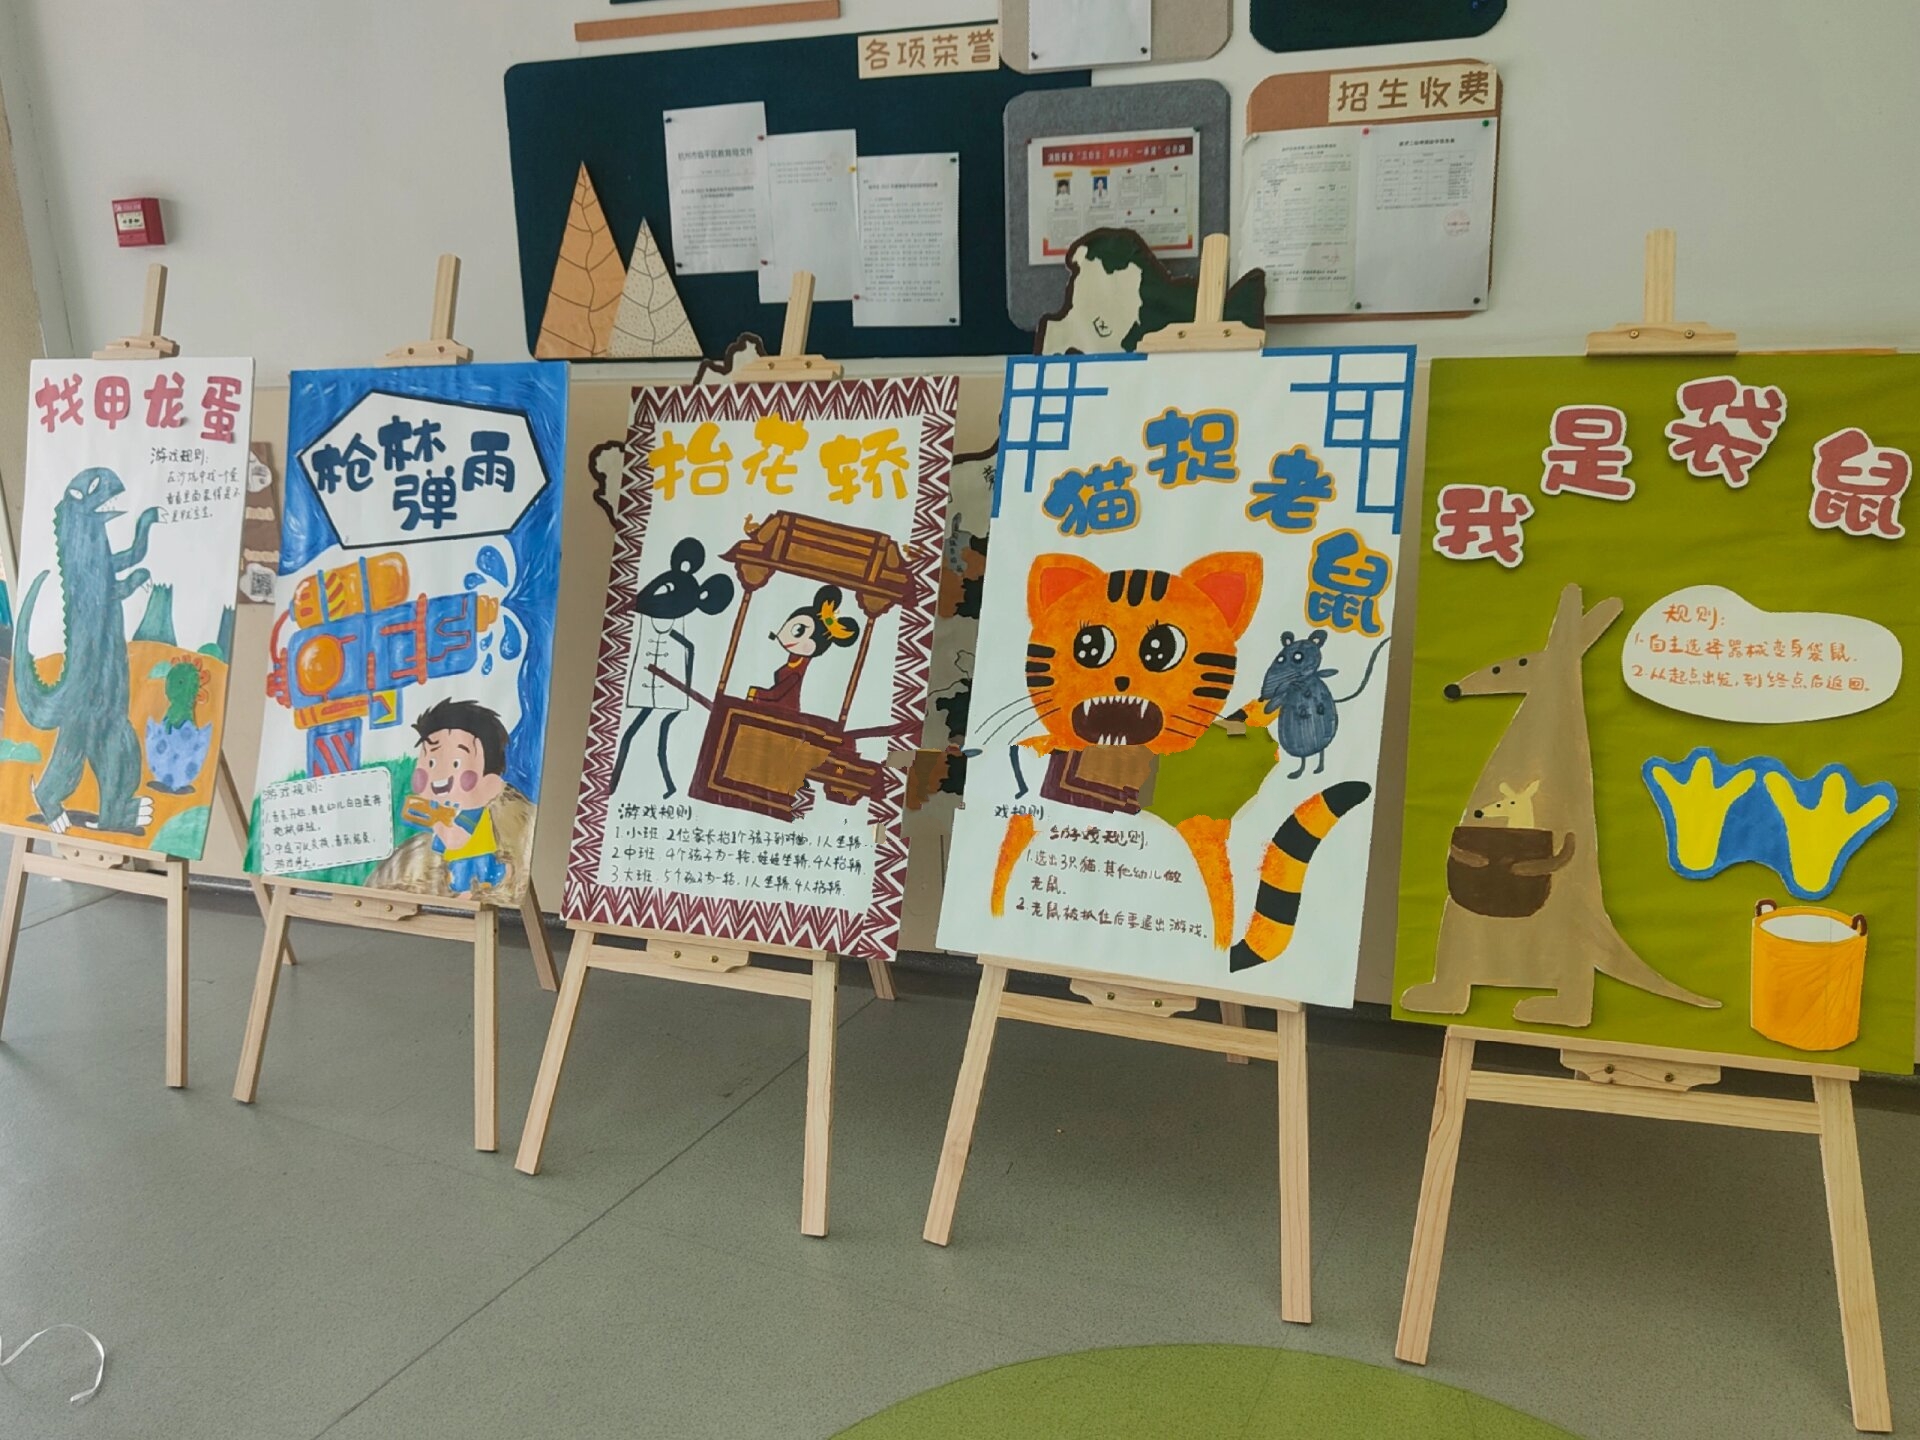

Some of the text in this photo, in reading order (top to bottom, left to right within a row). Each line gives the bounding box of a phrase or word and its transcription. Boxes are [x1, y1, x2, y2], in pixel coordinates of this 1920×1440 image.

[865, 28, 994, 70] 各项荣誉
[1337, 71, 1489, 112] 招生收费
[35, 371, 241, 443] 找甲龙蛋
[311, 415, 516, 531] 枪林弹雨
[648, 411, 910, 505] 抬花轿
[1434, 376, 1911, 567] 我是袋鼠
[1042, 406, 1393, 638] 猫捉老鼠
